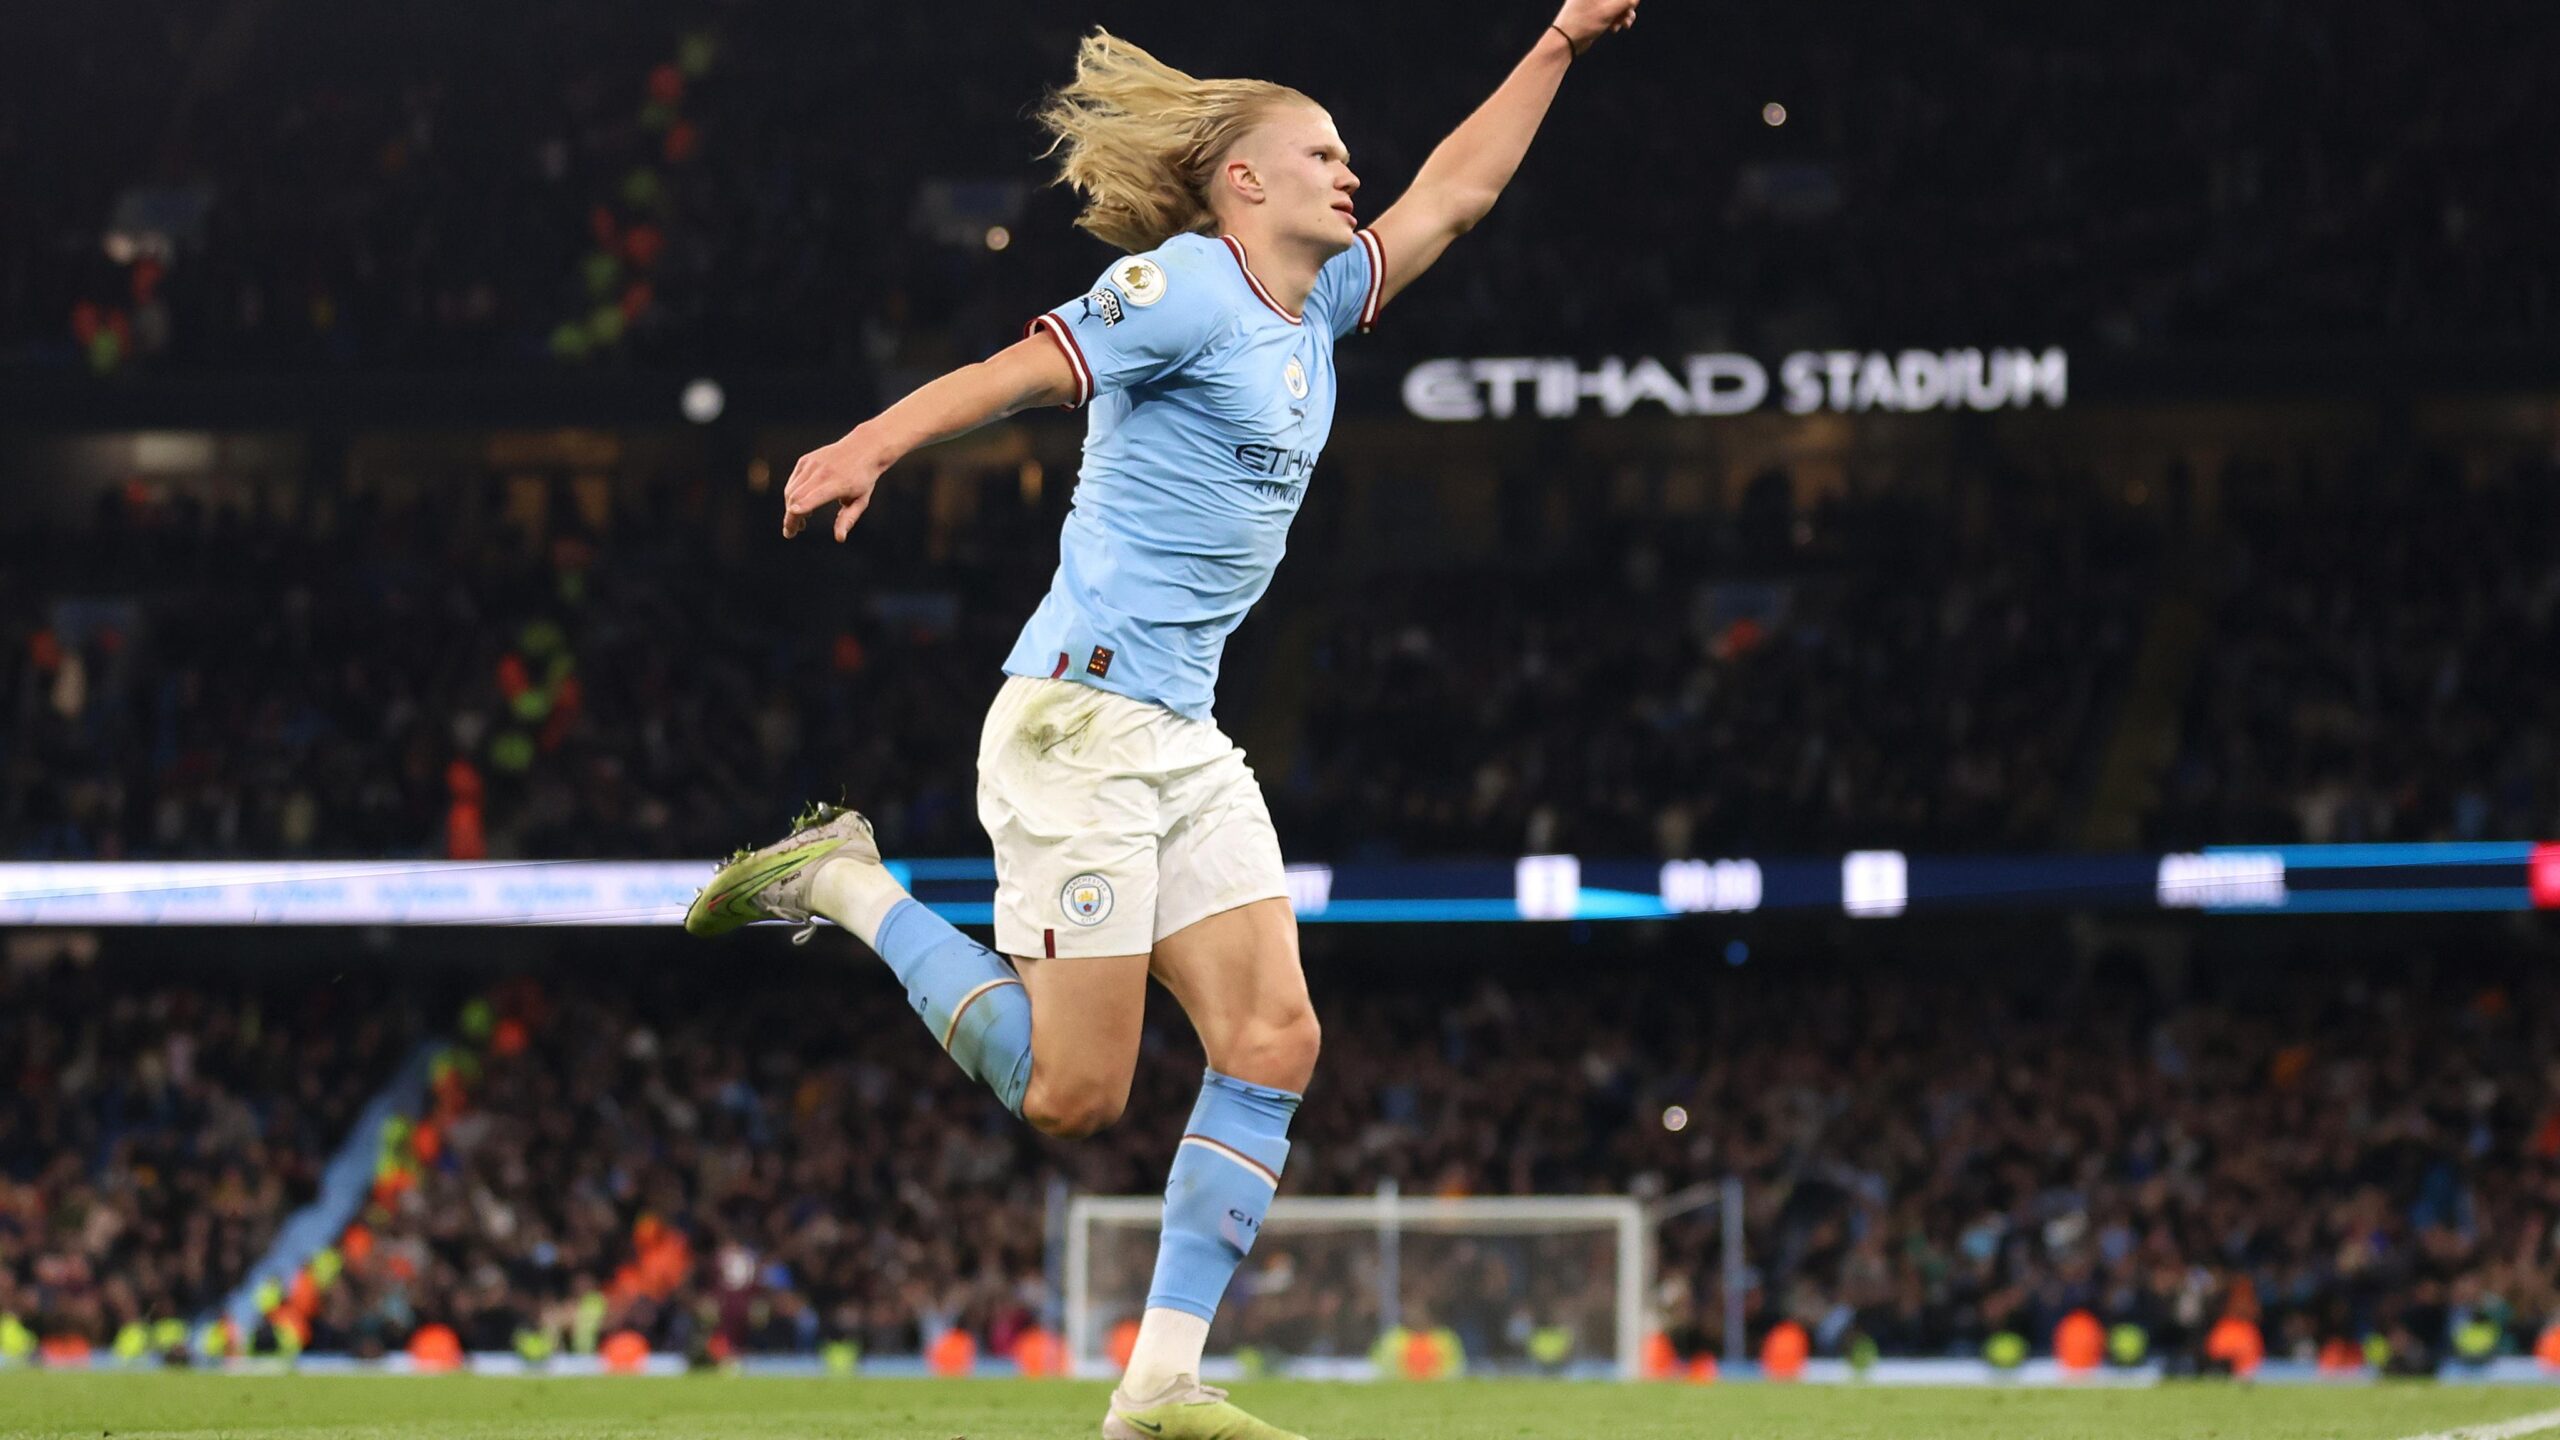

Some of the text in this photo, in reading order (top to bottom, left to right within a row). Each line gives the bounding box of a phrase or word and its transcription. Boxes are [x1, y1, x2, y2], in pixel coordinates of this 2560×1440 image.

[1402, 347, 2068, 421] ETIHAD STADIUM
[1254, 481, 1301, 505] AIRWA
